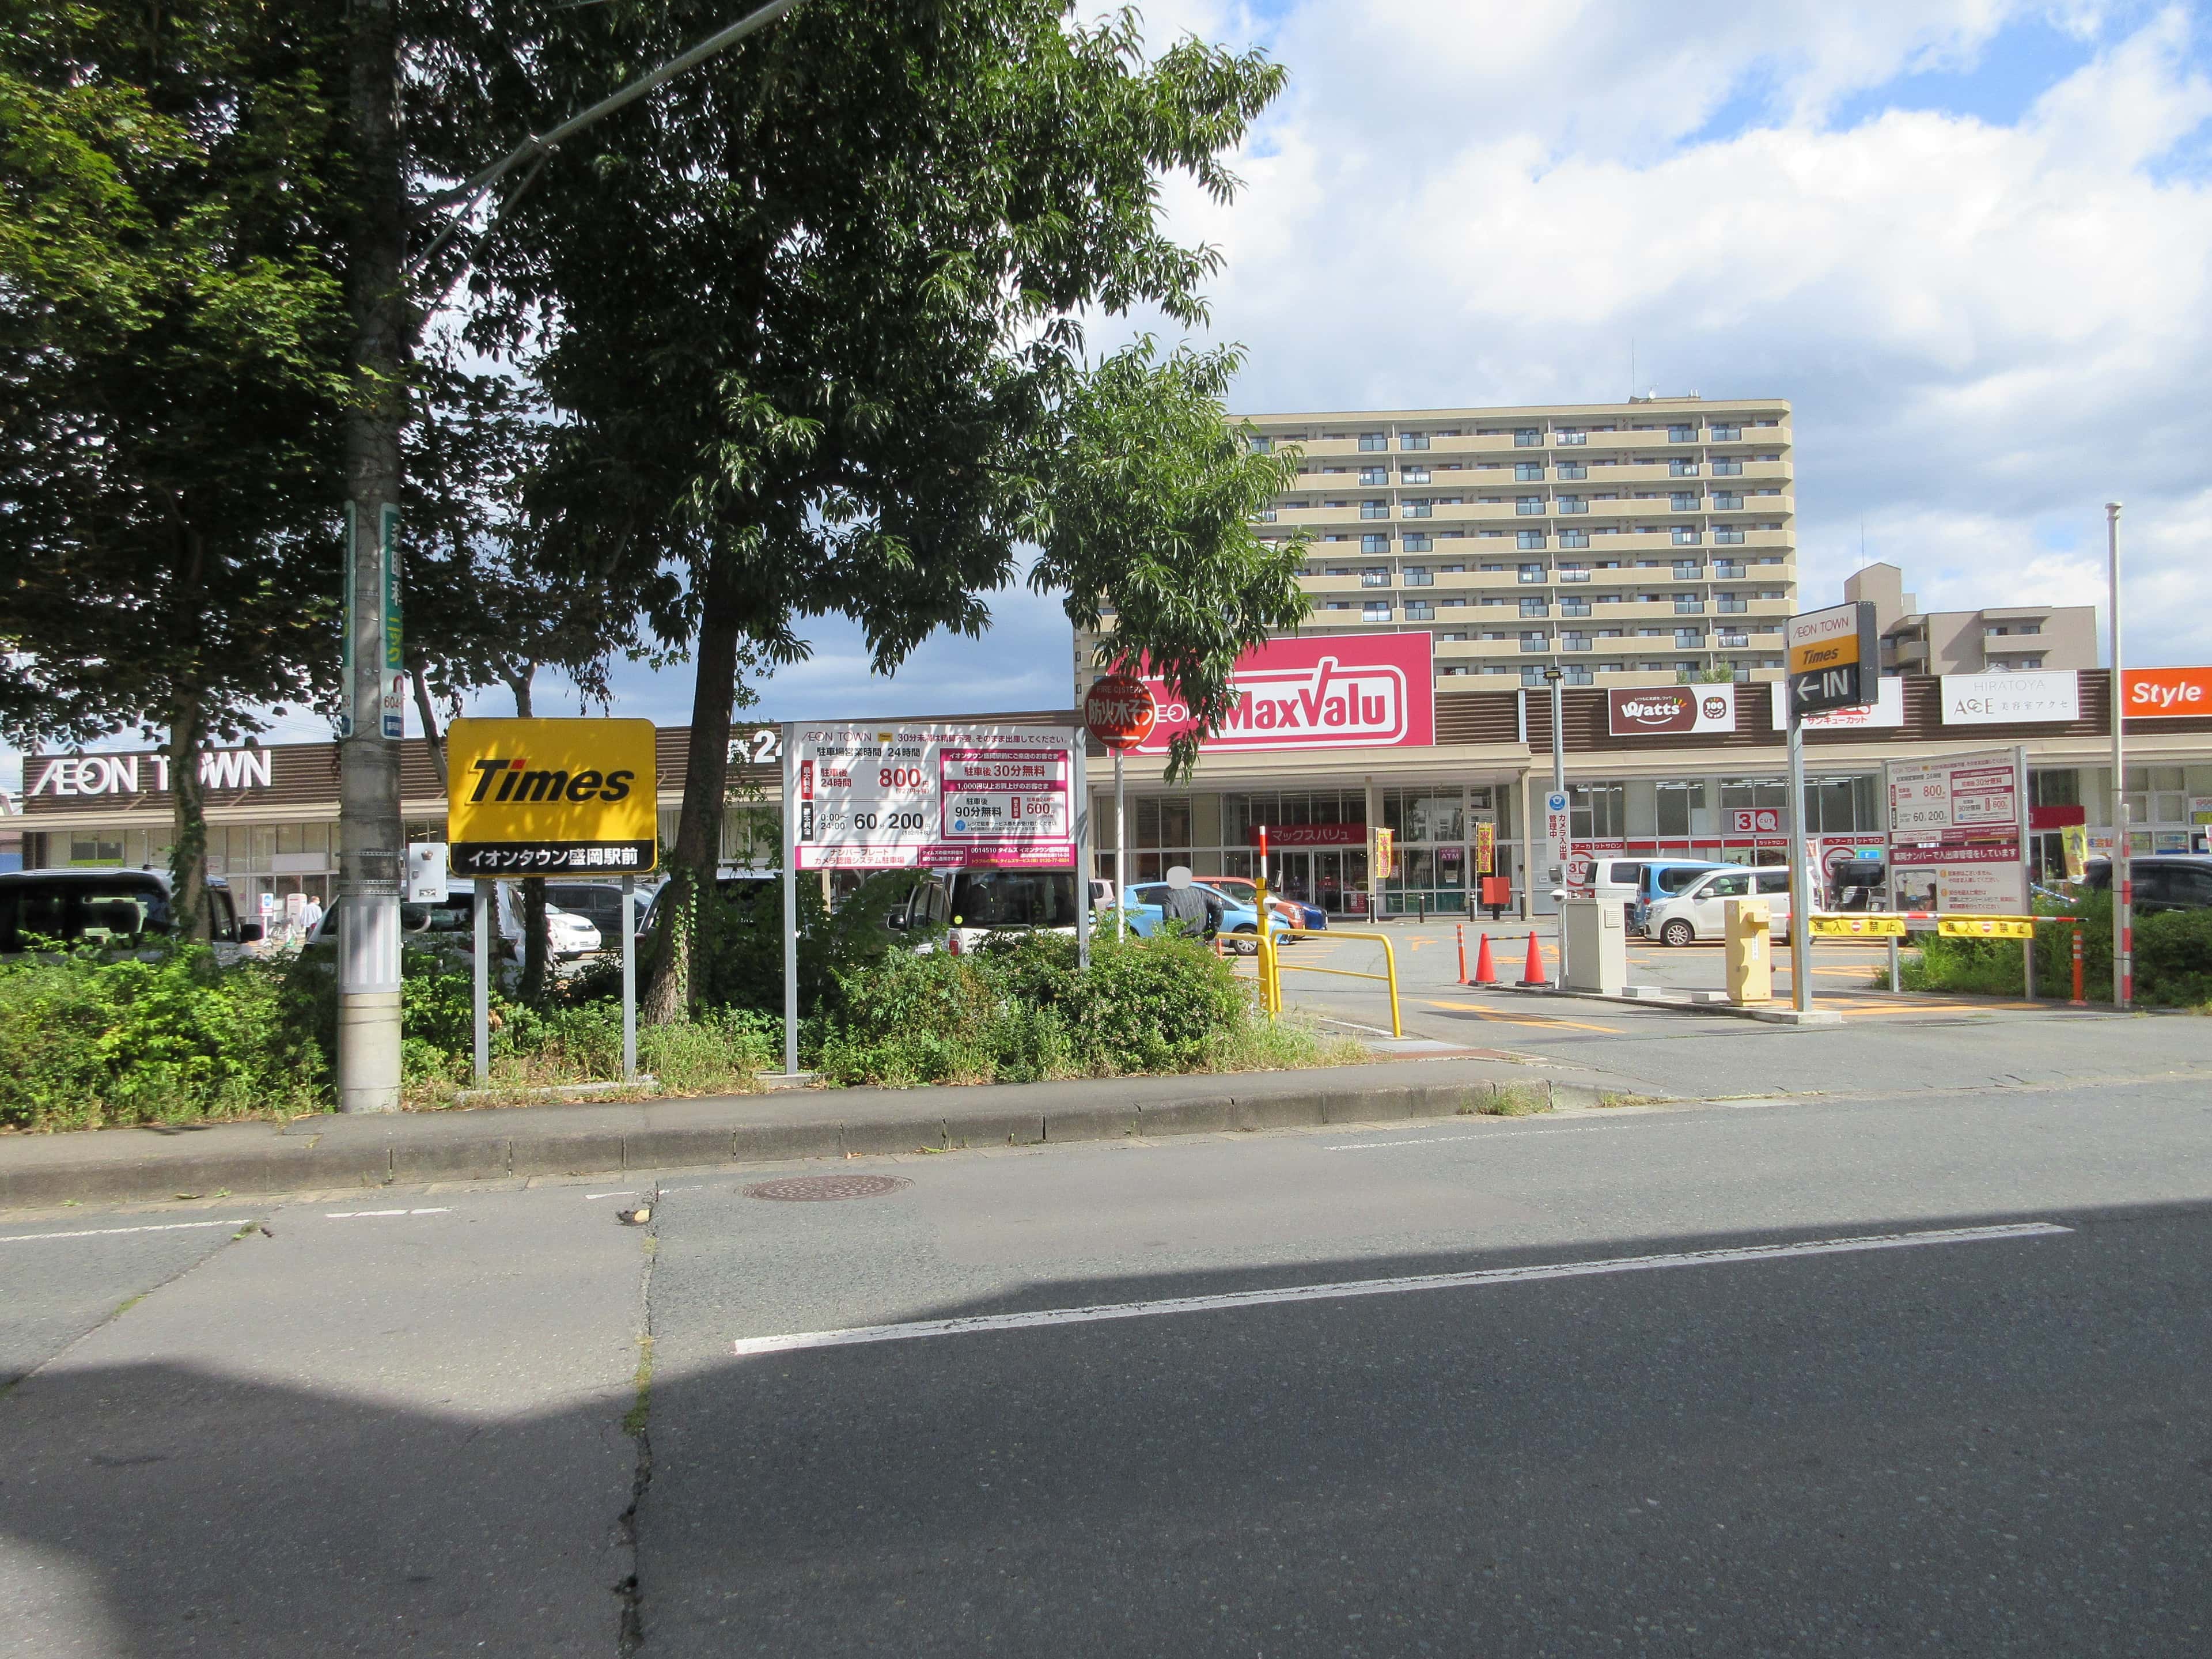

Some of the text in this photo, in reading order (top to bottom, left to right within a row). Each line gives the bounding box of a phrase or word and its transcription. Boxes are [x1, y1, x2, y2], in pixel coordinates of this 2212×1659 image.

[1820, 616, 1849, 632] TOWN
[1803, 648, 1839, 665] Times
[1823, 669, 1848, 698] IN
[1974, 680, 2046, 692] HIRATOYA
[1218, 661, 1385, 730] MaxValu
[2131, 681, 2201, 707] Style
[1621, 702, 1680, 718] Watts
[1806, 716, 1868, 725] サンキューカット
[838, 732, 872, 742] TOWN
[817, 747, 921, 757] 駐車場営業時間 24時間
[150, 750, 271, 791] TWN
[820, 768, 849, 777] 駐車後
[470, 759, 635, 802] Times
[820, 778, 852, 787] 24時間
[955, 806, 1002, 817] 90分無料
[820, 822, 845, 830] 24:00
[1549, 815, 1558, 838] 管理中
[1271, 829, 1350, 842] マックスバリュ
[1559, 814, 1567, 861] カメラ入出庫
[468, 847, 638, 867] イオンタウン盛岡駅前
[815, 857, 905, 865] カメラ認識システム駐車場
